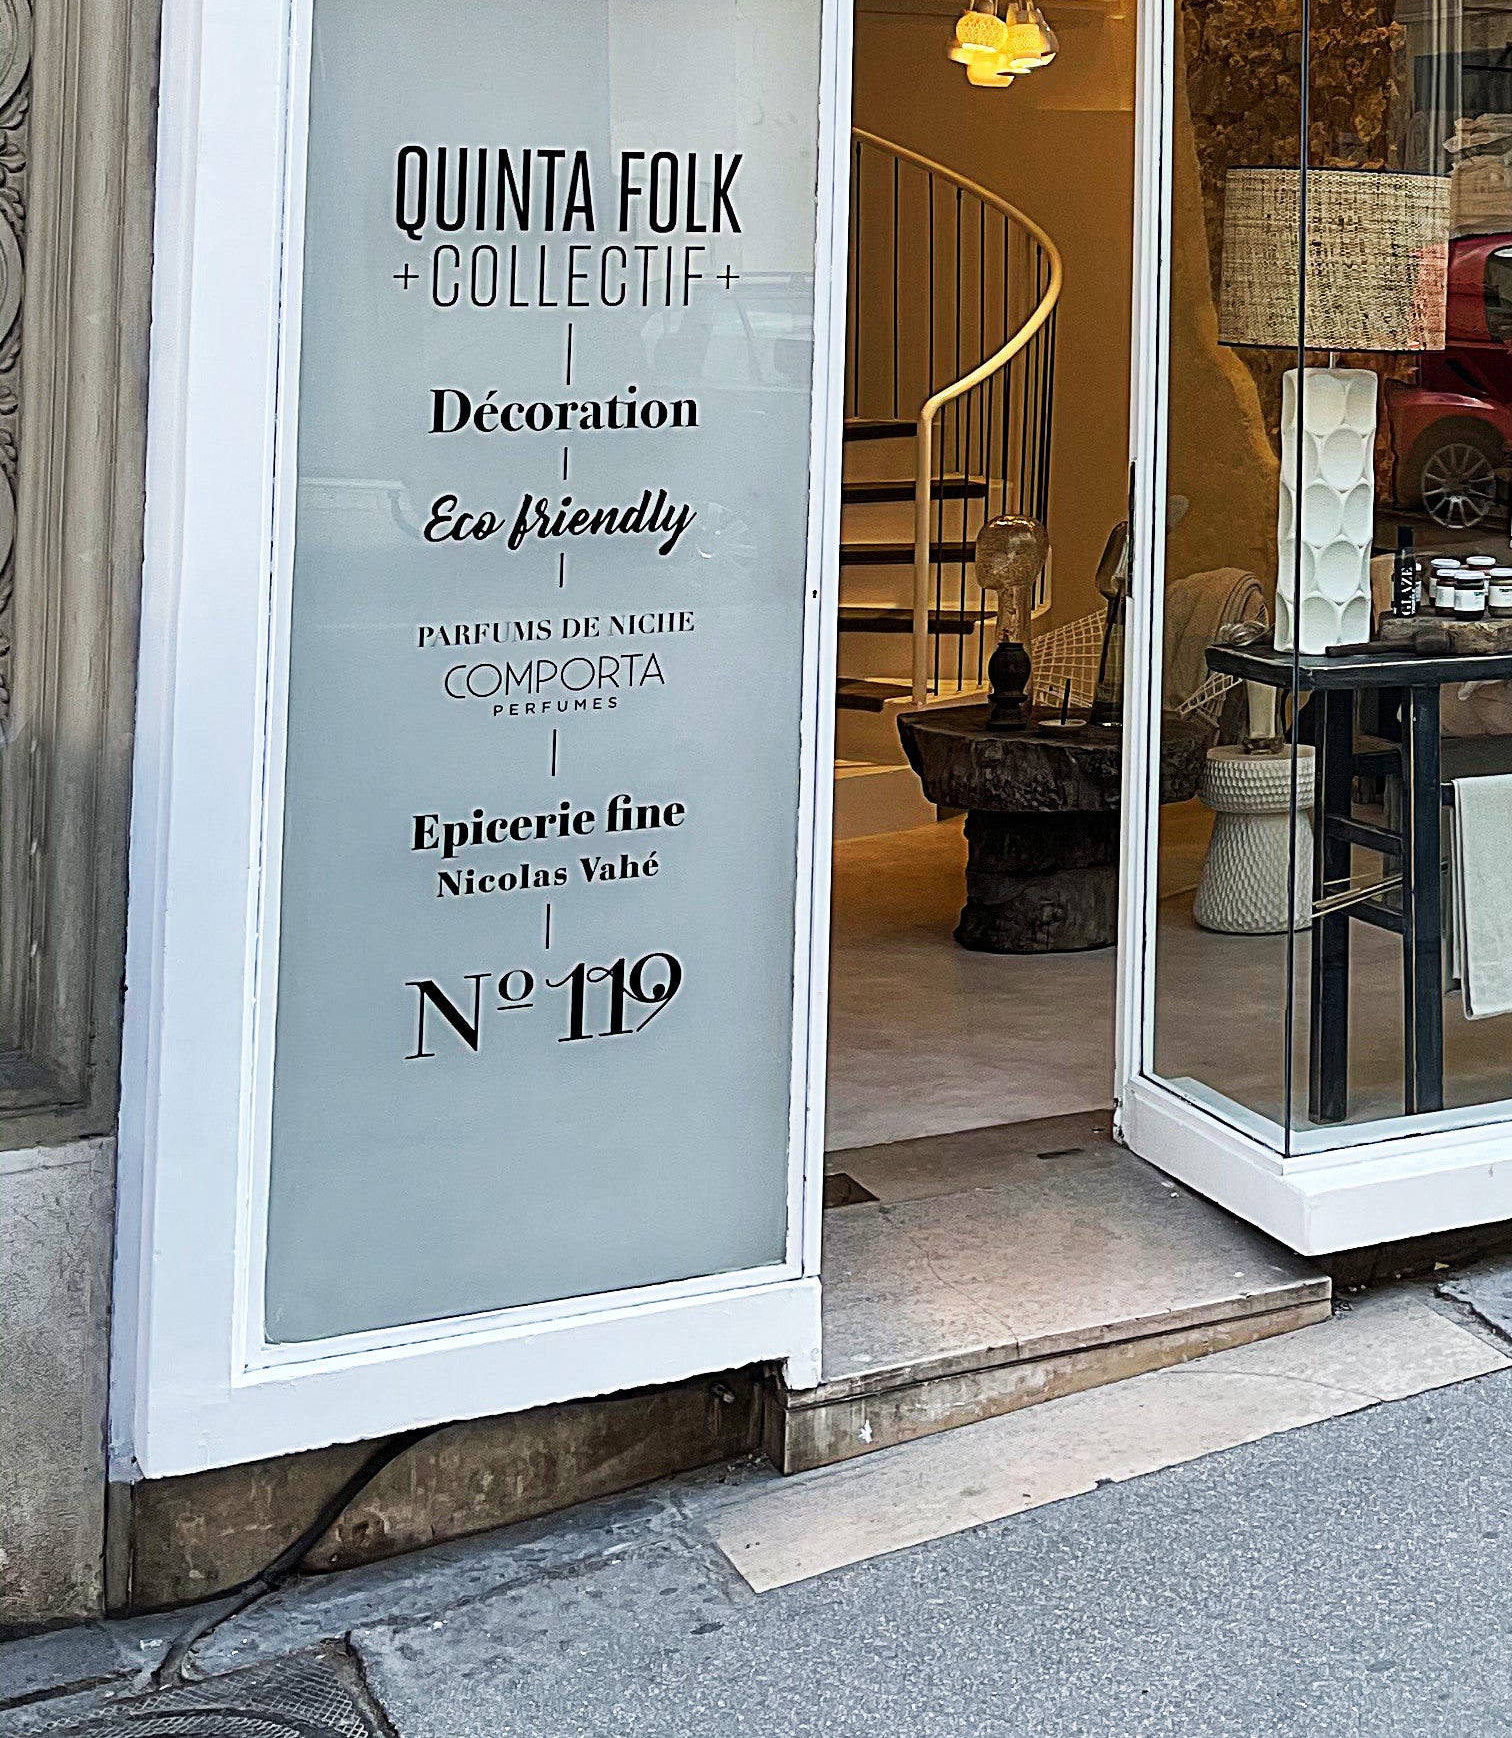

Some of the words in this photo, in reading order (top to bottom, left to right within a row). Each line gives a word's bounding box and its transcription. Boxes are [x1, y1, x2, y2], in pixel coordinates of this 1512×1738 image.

[396, 145, 596, 241] QUINTA
[619, 151, 744, 234] FOLK
[428, 385, 699, 435] Décoration
[423, 494, 506, 544] Eco
[507, 488, 699, 556] friendly
[417, 619, 553, 649] PARFUMS
[562, 617, 601, 640] DE
[608, 611, 696, 638] NICHE
[443, 652, 666, 700] COMPORTA
[492, 695, 619, 717] PERFUMES
[411, 801, 597, 859] Epicerie
[606, 793, 687, 835] fine
[436, 861, 569, 899] Nicolas
[579, 850, 661, 884] Vahé
